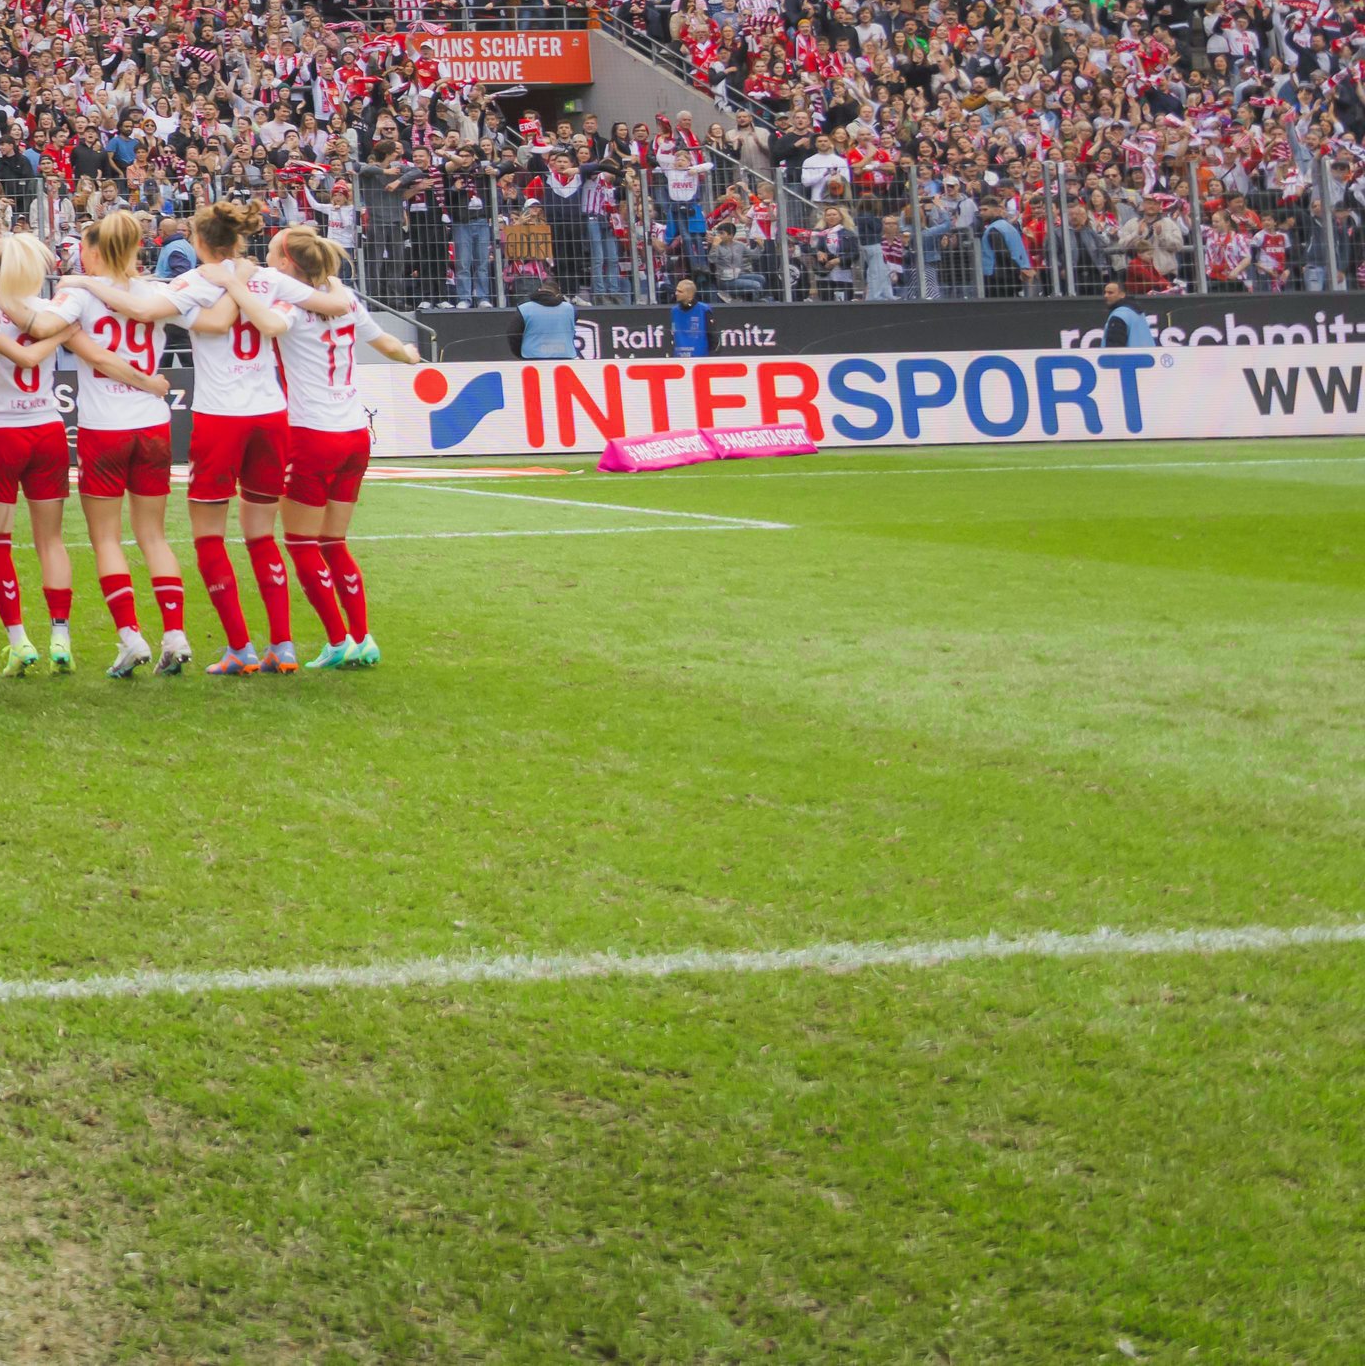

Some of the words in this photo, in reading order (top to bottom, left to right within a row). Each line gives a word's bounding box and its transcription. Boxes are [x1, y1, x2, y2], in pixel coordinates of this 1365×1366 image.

[430, 37, 474, 58] HANS
[480, 34, 562, 57] SCHÄFER
[320, 323, 356, 387] 17
[611, 324, 664, 349] Ralf
[520, 353, 1156, 449] INTERSPORT
